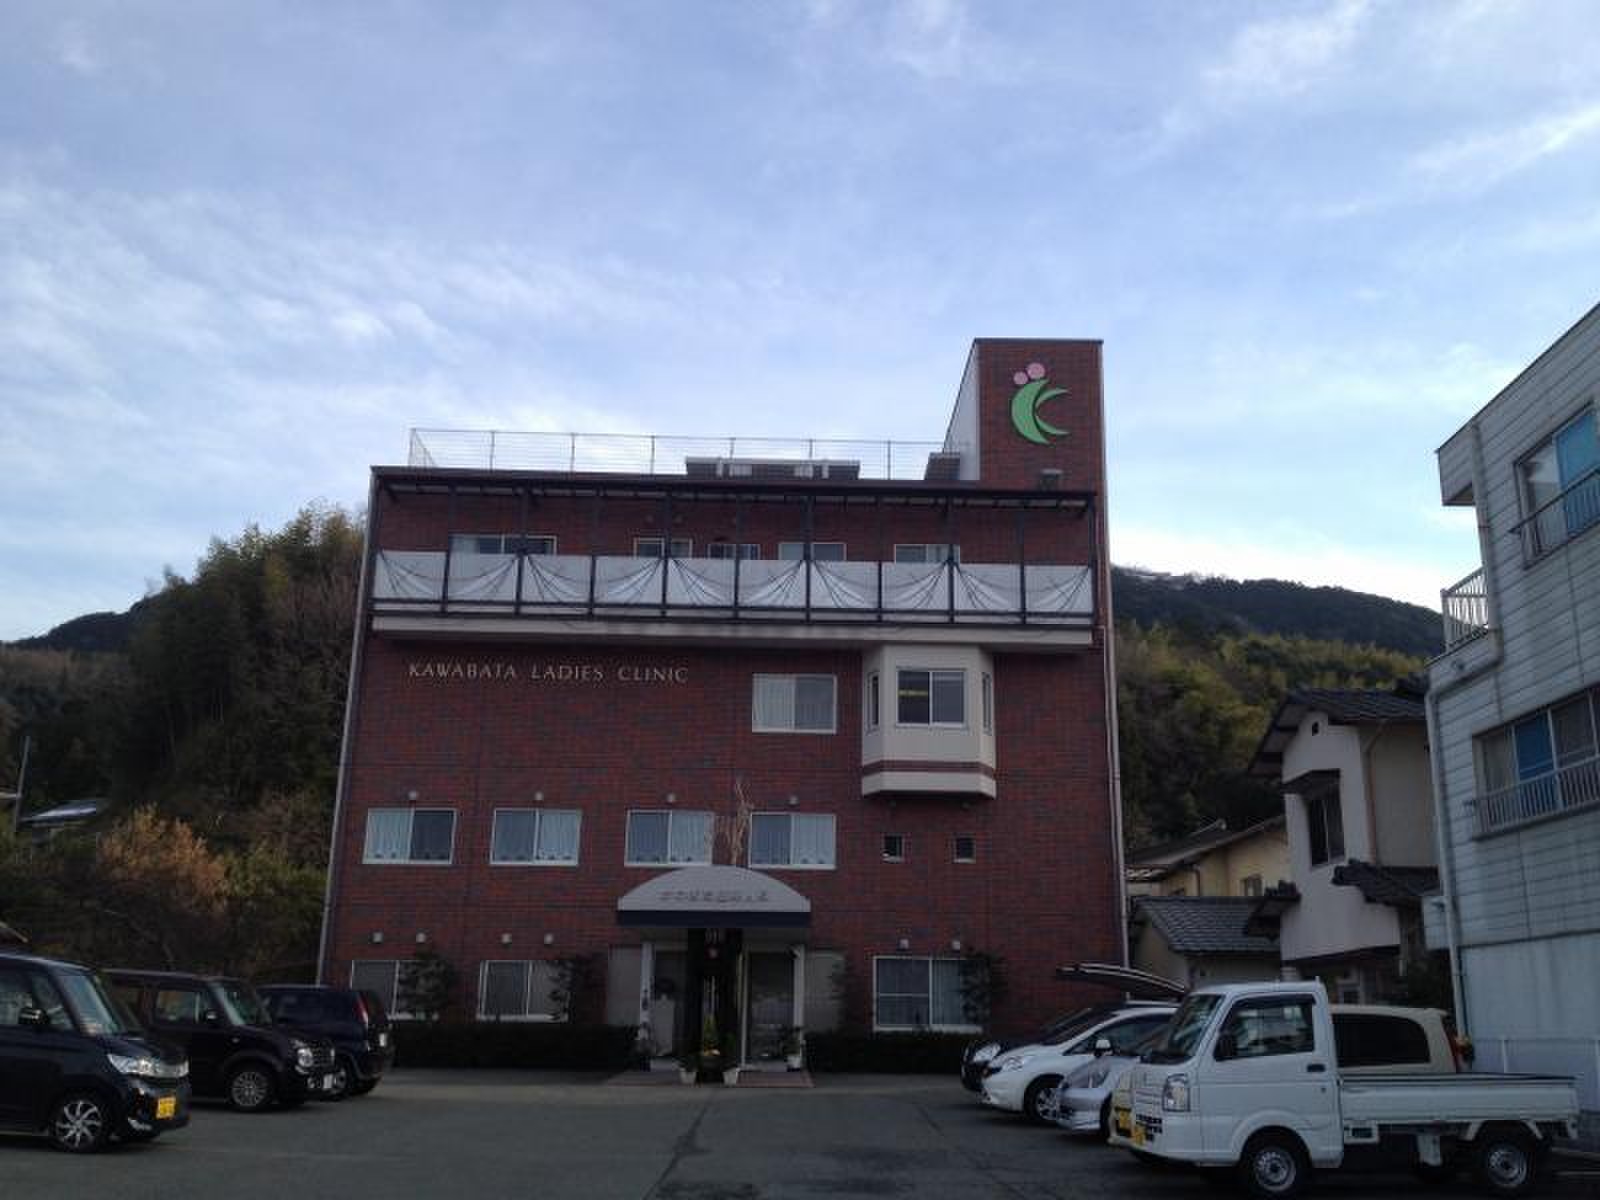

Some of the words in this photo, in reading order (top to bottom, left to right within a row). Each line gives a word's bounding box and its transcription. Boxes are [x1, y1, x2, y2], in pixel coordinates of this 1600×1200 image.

[409, 662, 517, 679] KAWABATA
[530, 664, 604, 681] LADIES
[617, 666, 688, 683] CLINIC
